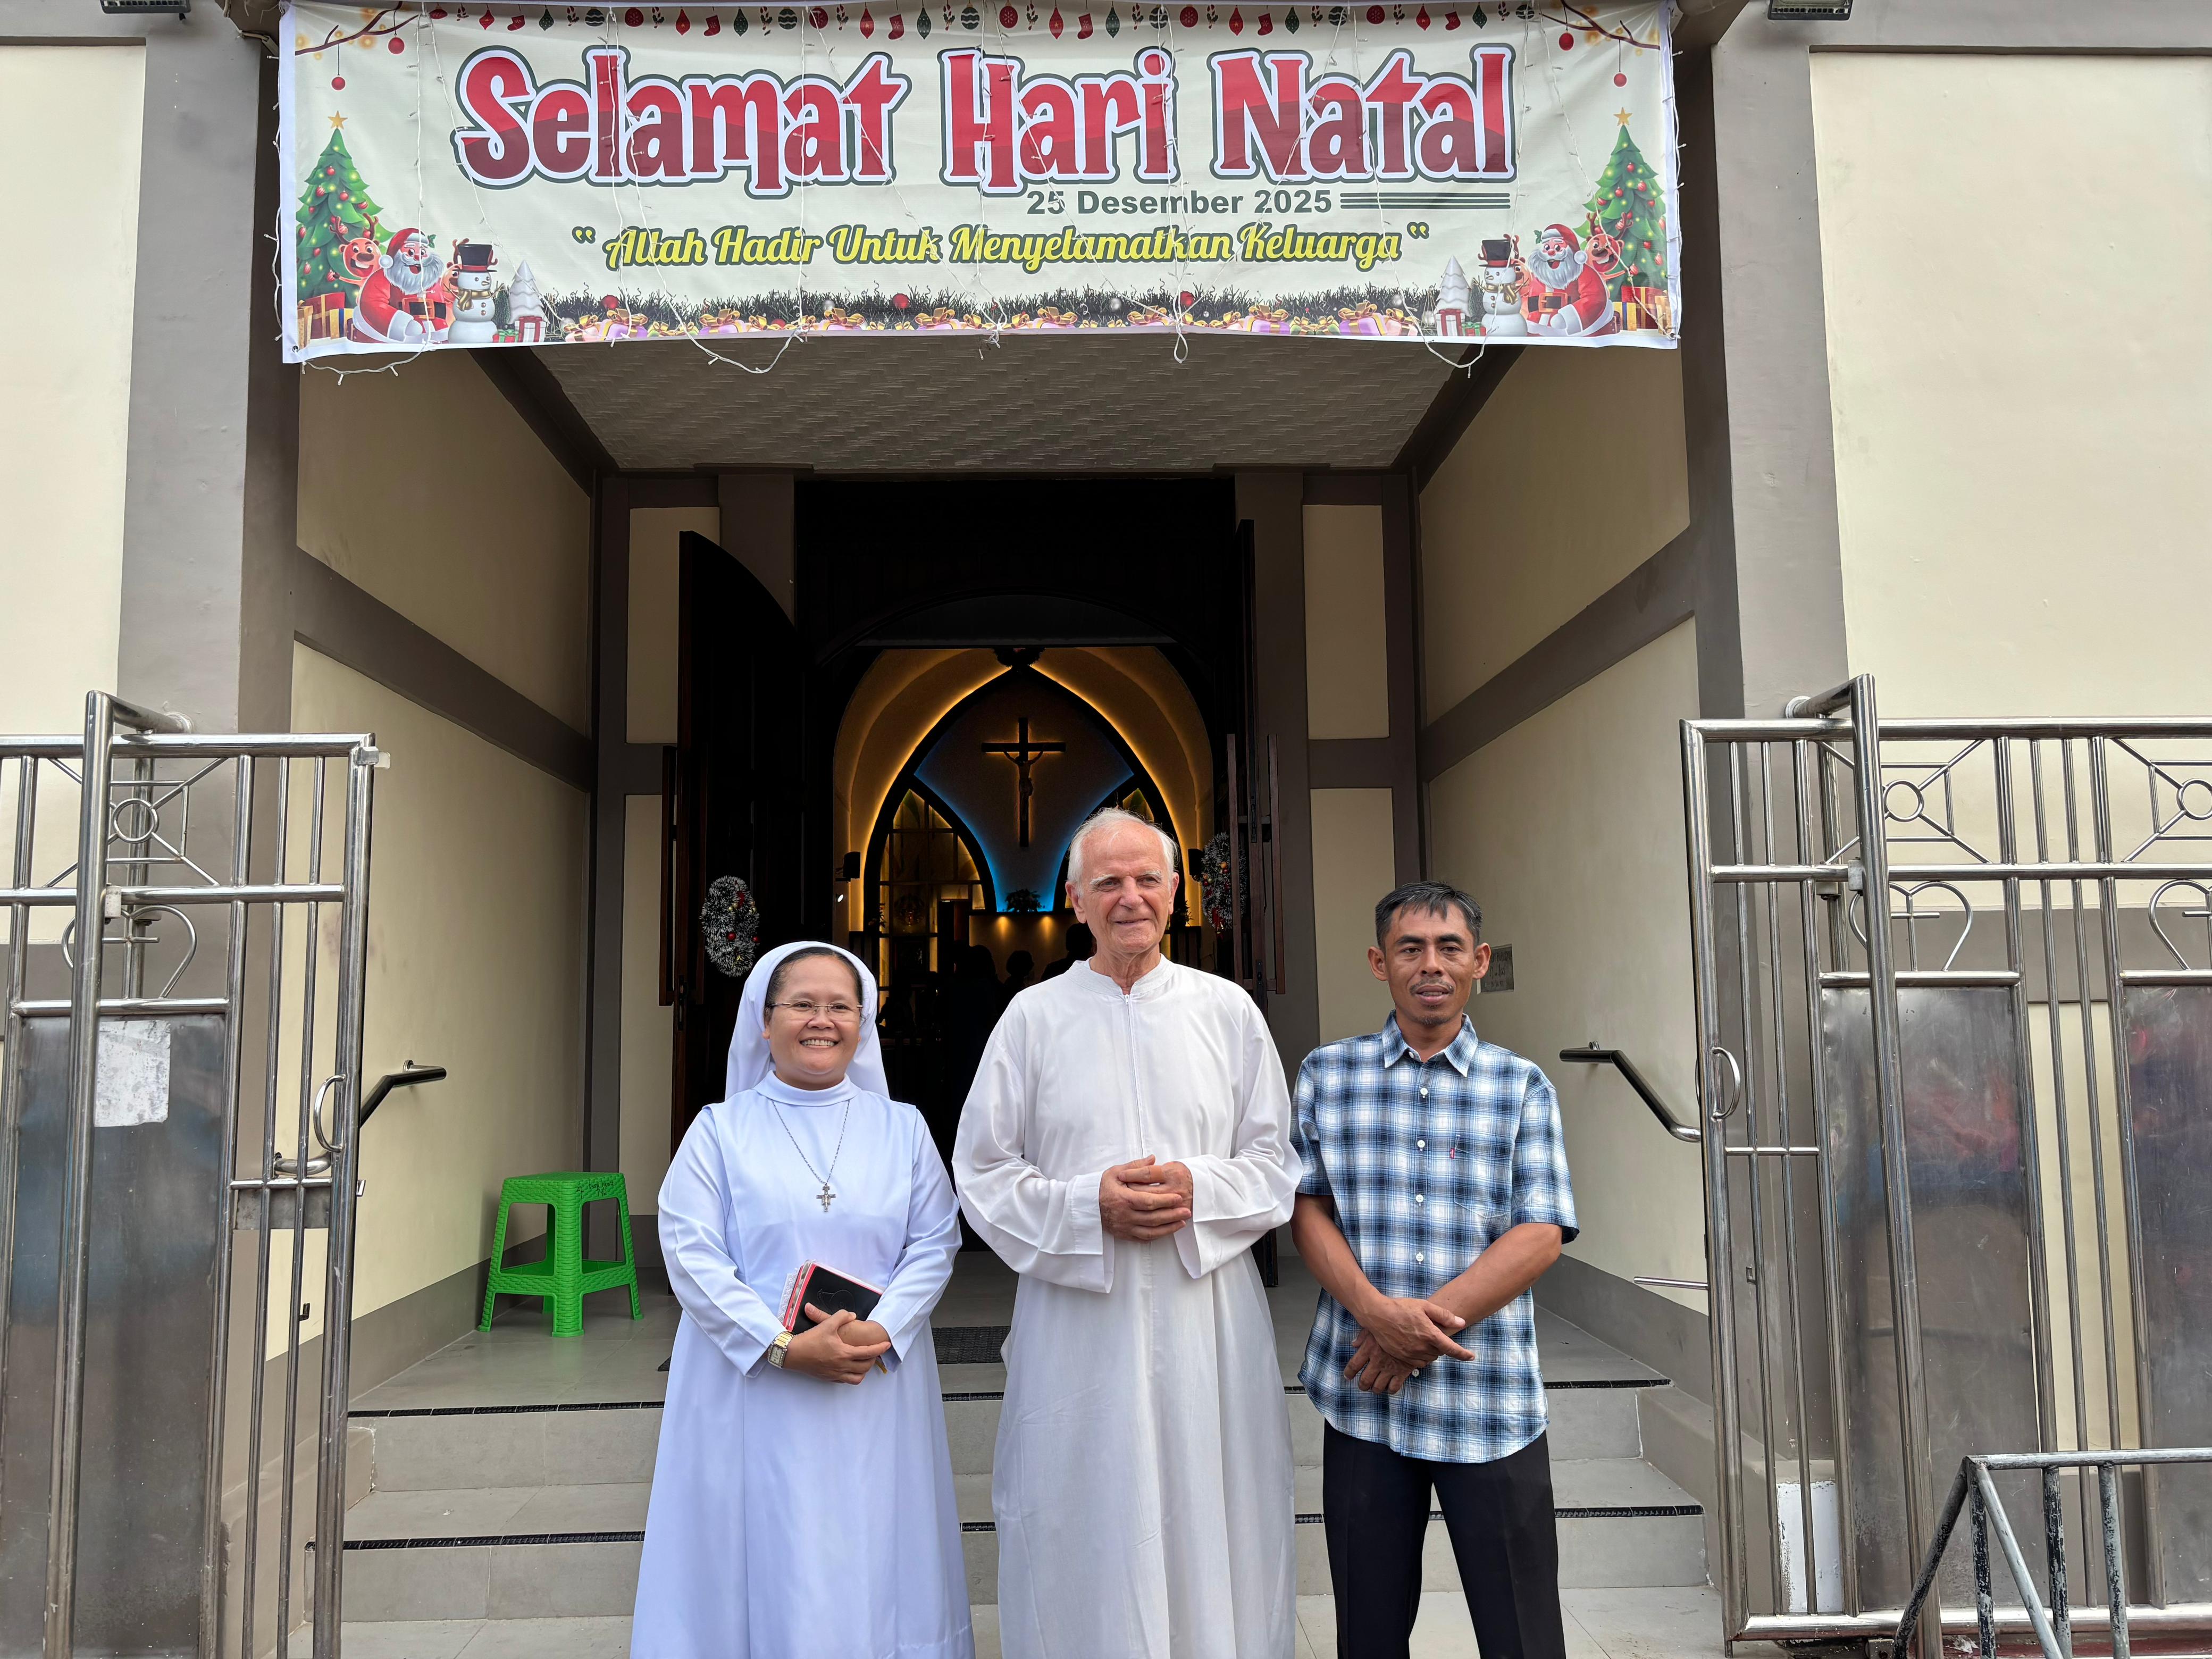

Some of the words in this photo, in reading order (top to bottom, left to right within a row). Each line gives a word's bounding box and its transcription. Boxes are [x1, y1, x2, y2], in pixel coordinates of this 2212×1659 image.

[450, 45, 912, 200] Selamat
[938, 46, 1177, 198] Hari
[1206, 44, 1518, 184] Natal
[1026, 190, 1065, 215] 25
[1077, 190, 1244, 214] Desember
[1254, 190, 1332, 214] 2025
[602, 225, 708, 272] Allah
[710, 225, 824, 266] Hadir
[825, 224, 944, 266] Untuk
[946, 224, 1234, 275] Menyelamatkan
[1237, 222, 1402, 272] Keluarga
